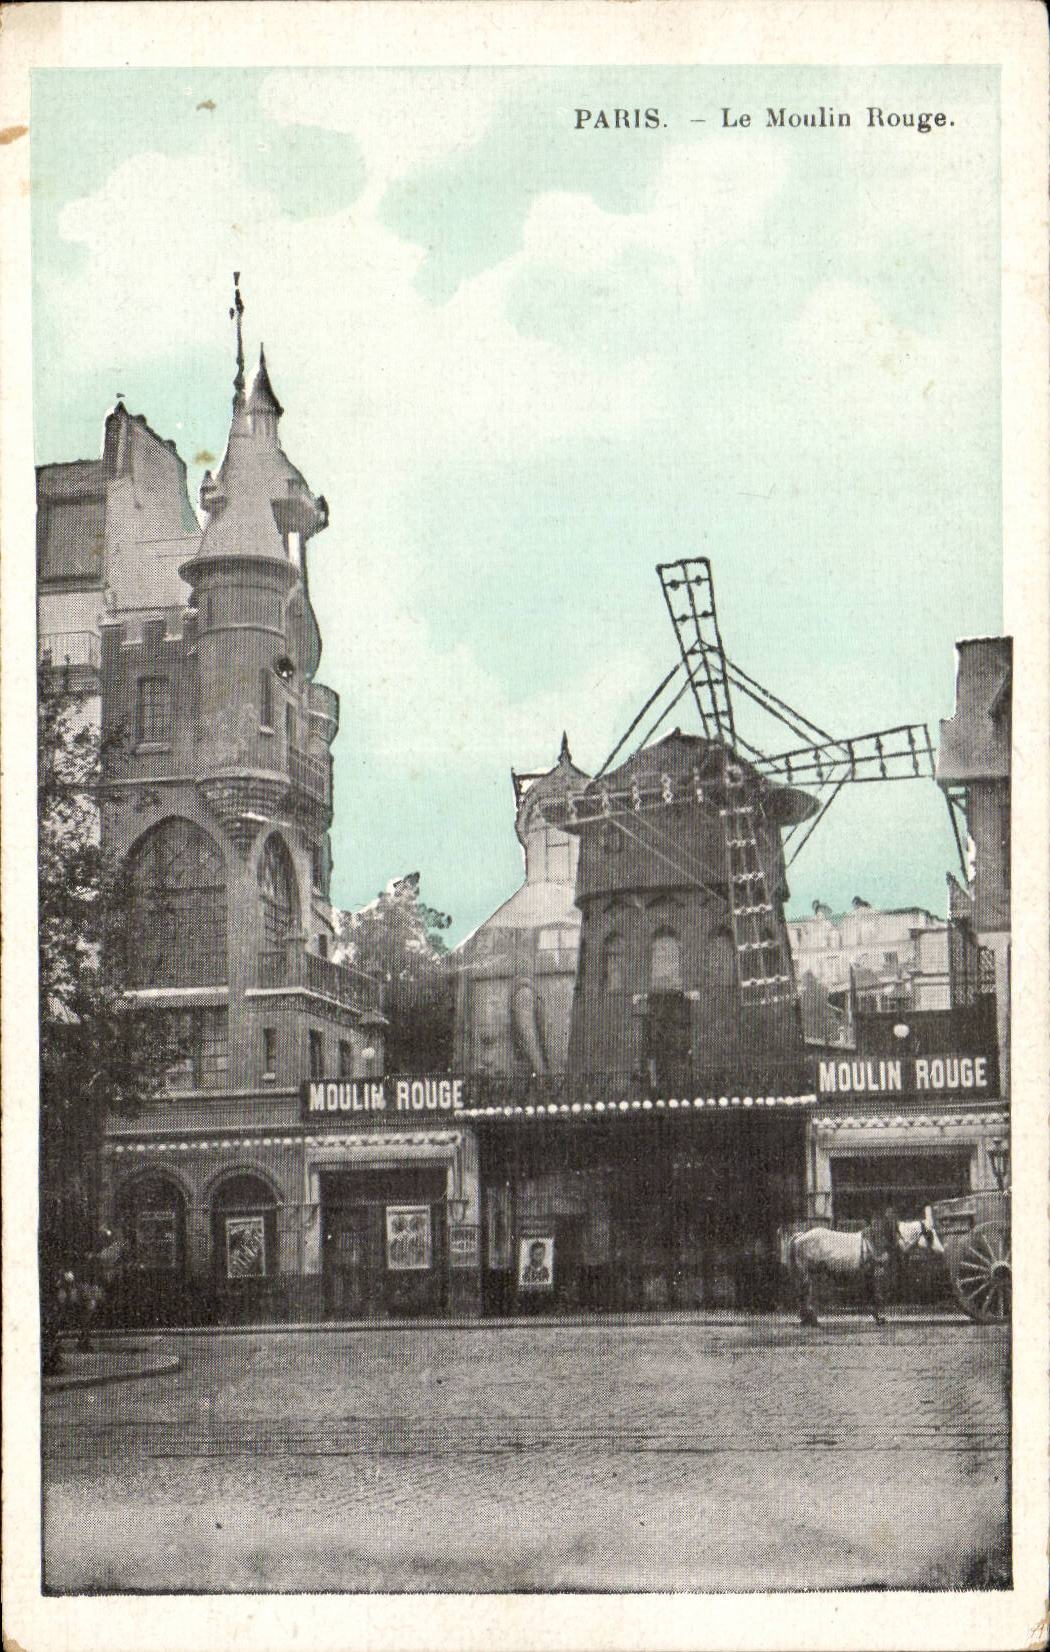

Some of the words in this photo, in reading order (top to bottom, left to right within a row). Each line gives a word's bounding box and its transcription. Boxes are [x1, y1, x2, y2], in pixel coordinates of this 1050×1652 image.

[819, 1060, 902, 1092] MOULIN
[915, 1057, 988, 1090] ROUGE
[309, 1082, 386, 1111] MOULIN
[397, 1079, 464, 1110] ROUGE
